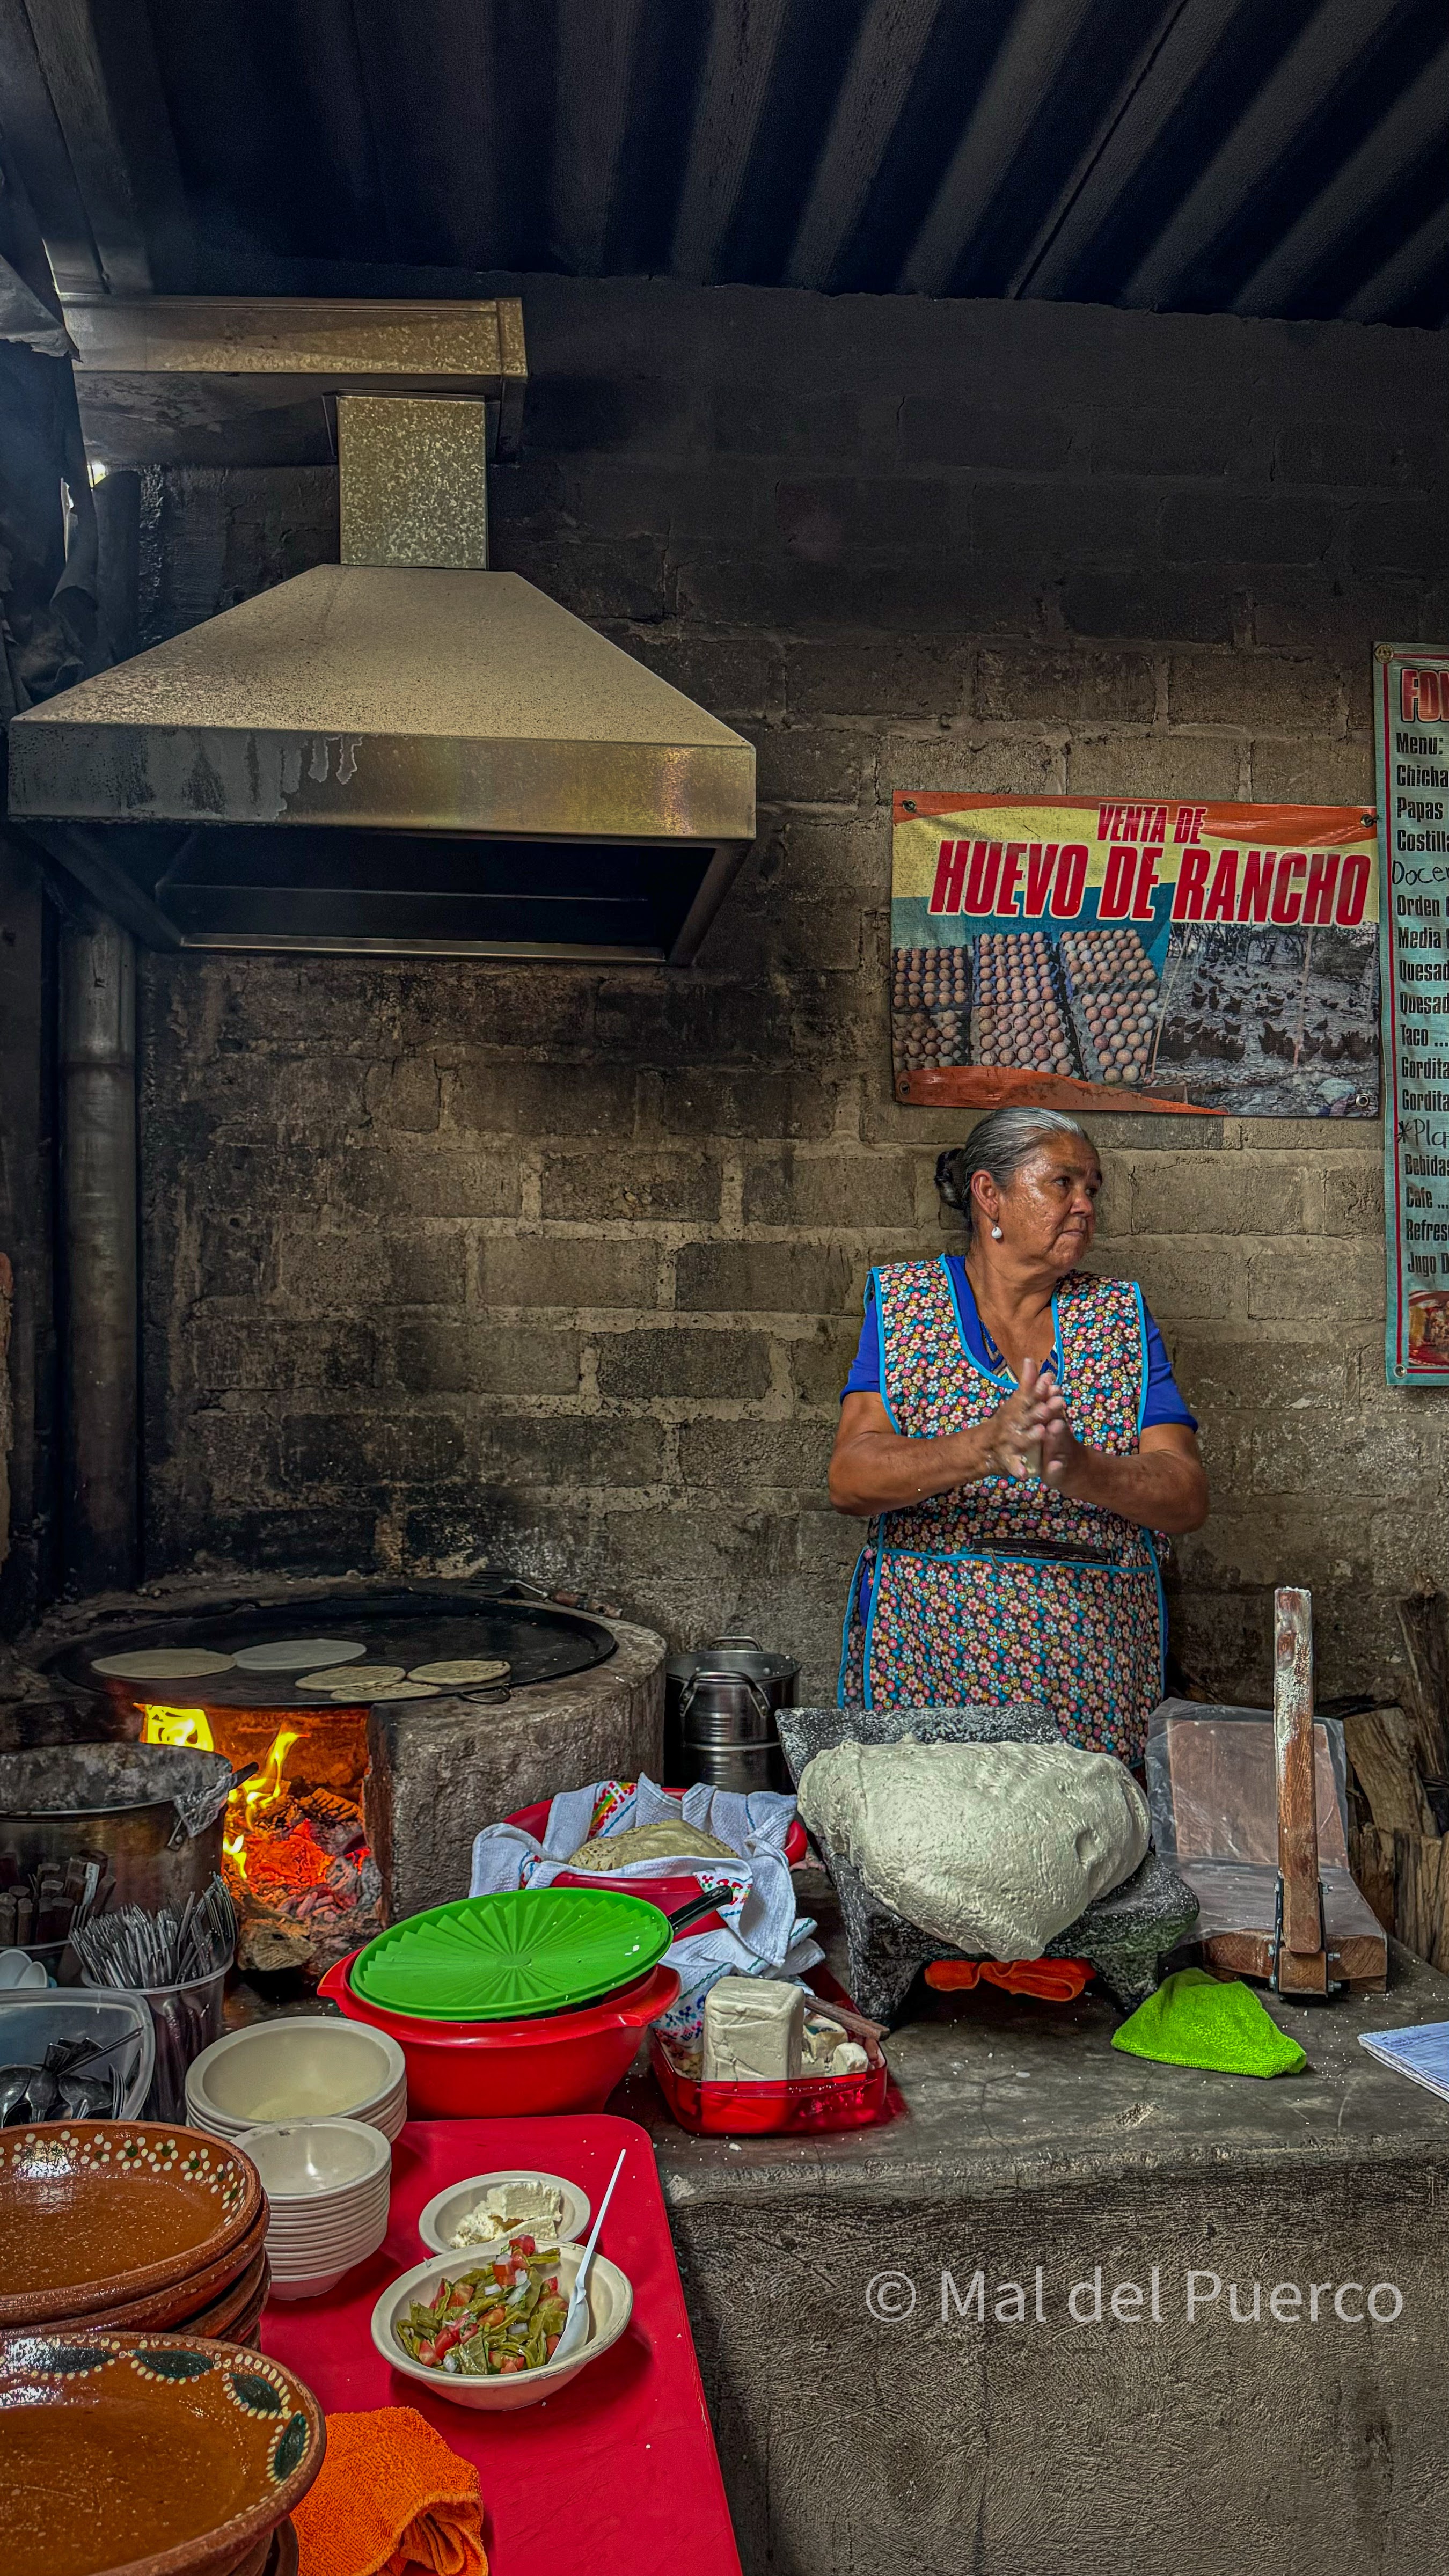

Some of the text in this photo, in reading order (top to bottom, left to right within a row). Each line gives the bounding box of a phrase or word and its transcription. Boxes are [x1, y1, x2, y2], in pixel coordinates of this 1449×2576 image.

[1396, 732, 1444, 755] Menu:
[1397, 796, 1443, 823] Papas
[1097, 803, 1208, 844] VENTA DE
[929, 839, 1371, 928] HUEVO DE RANCHO
[1397, 894, 1440, 917] Orden
[1397, 927, 1441, 949] Media
[1400, 1024, 1429, 1046] Taco
[1406, 1185, 1433, 1208] Cafe
[1406, 1218, 1449, 1241] Refres
[1407, 1251, 1437, 1277] Jugo
